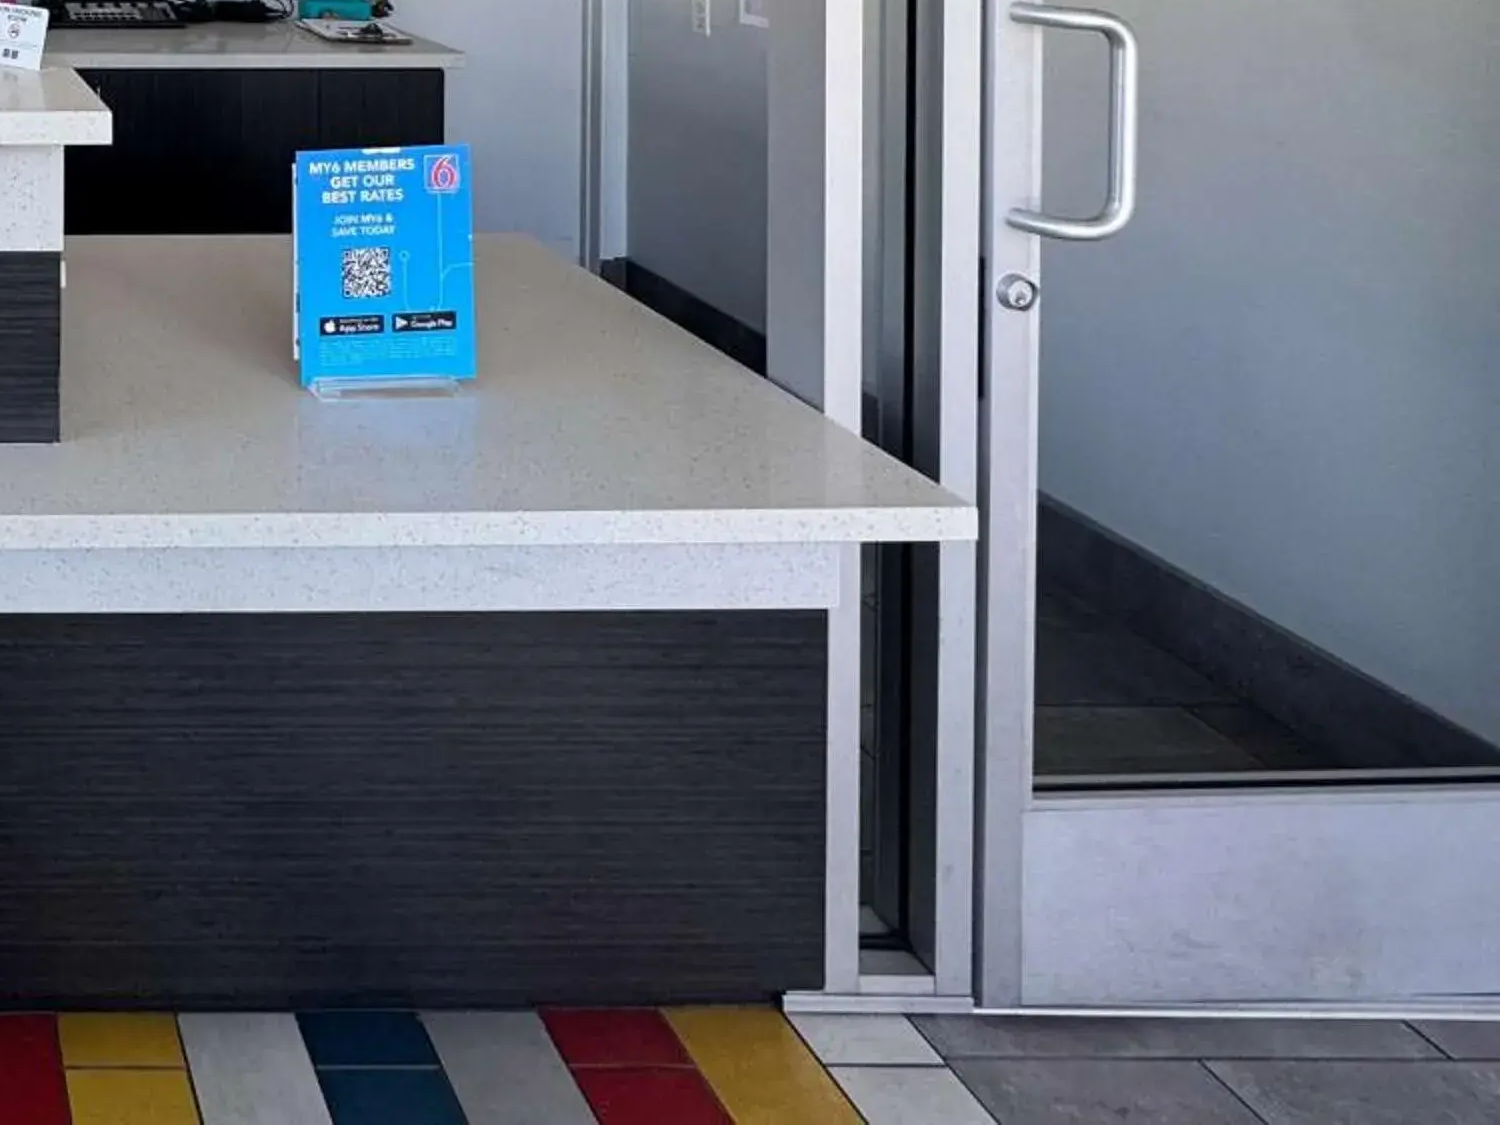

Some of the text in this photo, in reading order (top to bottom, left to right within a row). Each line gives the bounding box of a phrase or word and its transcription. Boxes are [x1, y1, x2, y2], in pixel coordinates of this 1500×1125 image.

[309, 158, 415, 175] MY6 MEMBERS
[330, 174, 395, 189] GET OUR
[322, 189, 404, 204] BEST RATES
[331, 225, 395, 238] SAVE TODAY
